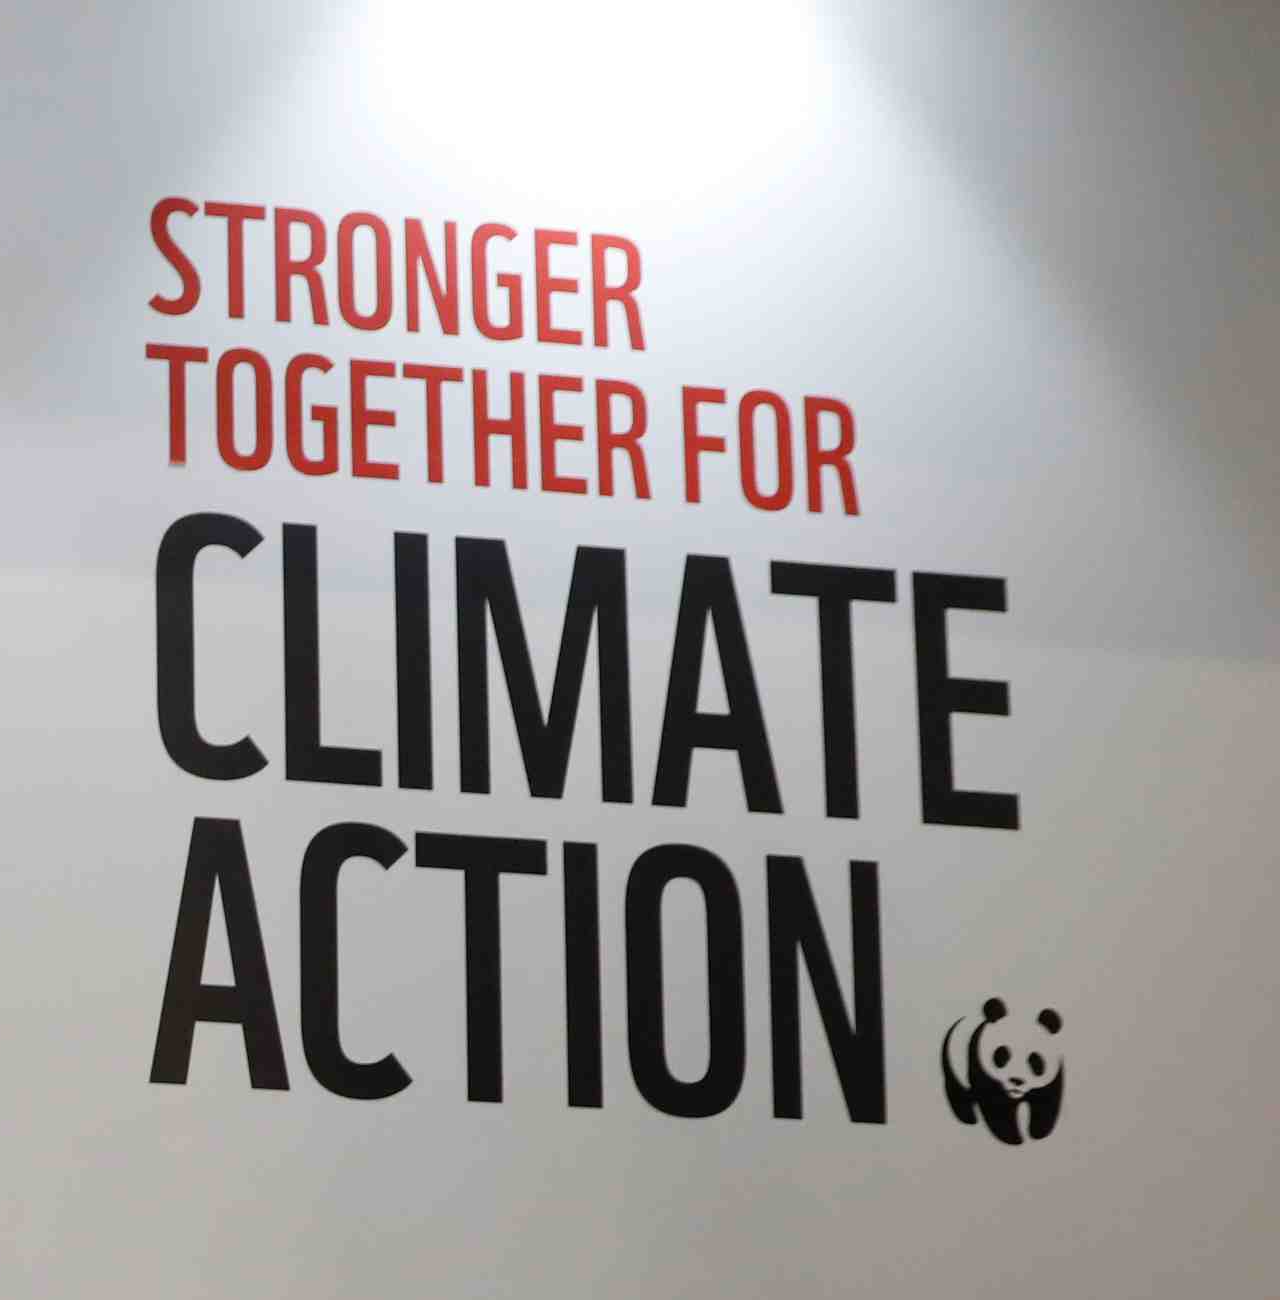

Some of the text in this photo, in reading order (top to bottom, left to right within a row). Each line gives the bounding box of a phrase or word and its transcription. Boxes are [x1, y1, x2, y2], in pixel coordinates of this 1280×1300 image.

[148, 196, 647, 351] STRONGER
[146, 343, 859, 516] TOGETHER FOR
[155, 512, 1020, 831] CLIMATE
[149, 816, 887, 1125] ACTION
